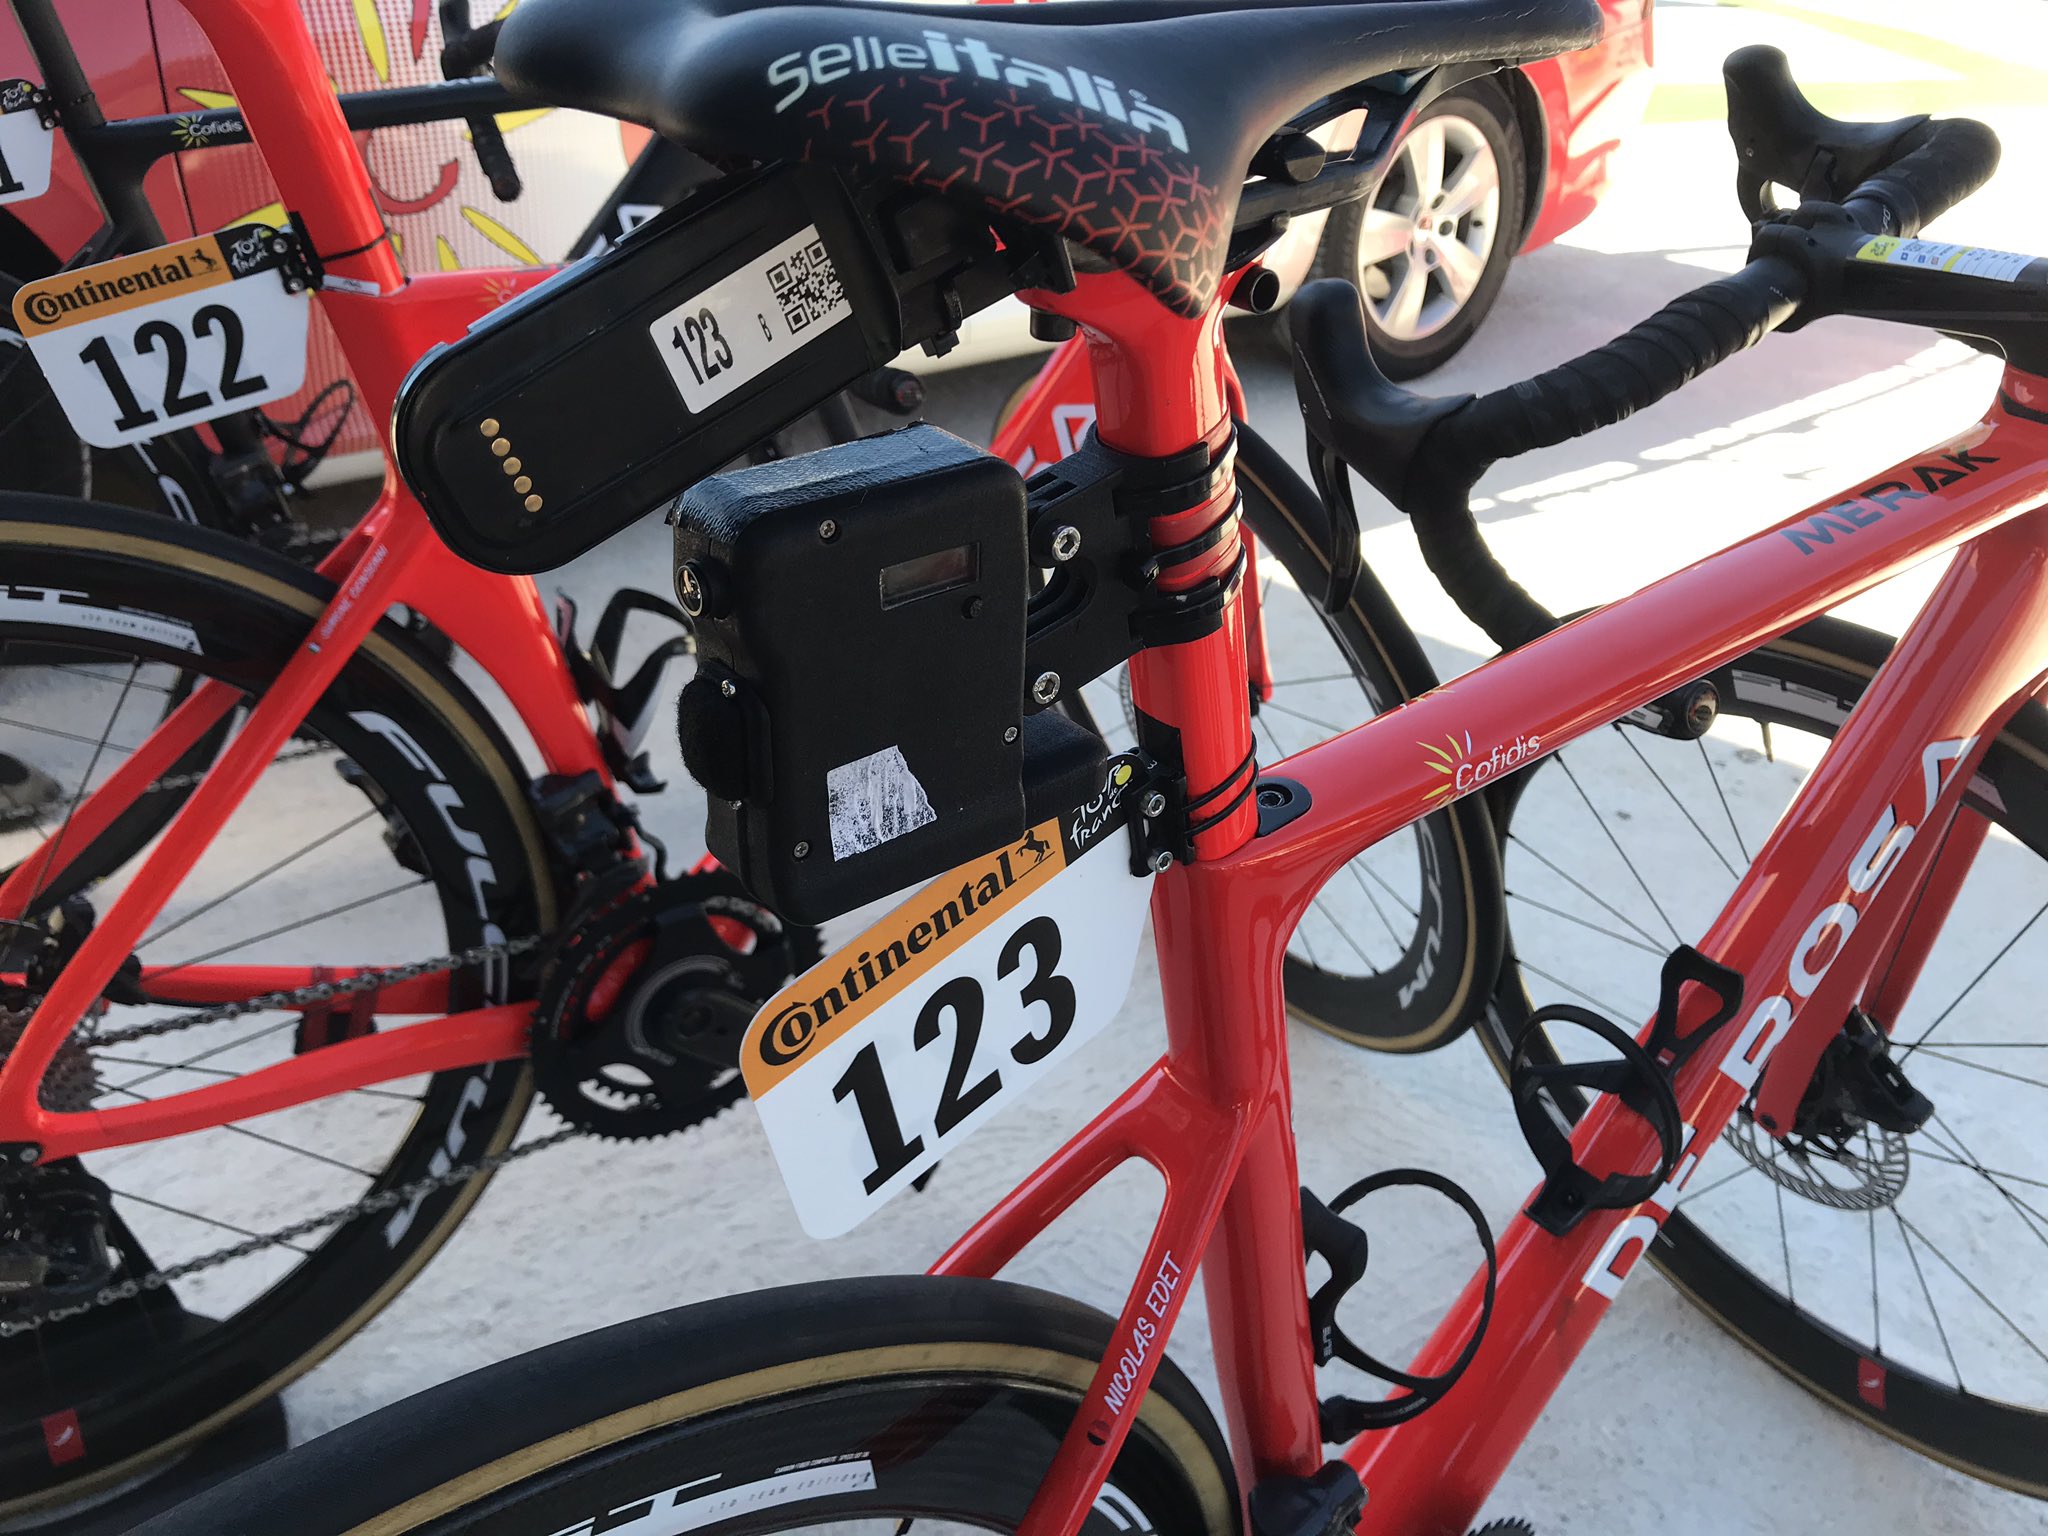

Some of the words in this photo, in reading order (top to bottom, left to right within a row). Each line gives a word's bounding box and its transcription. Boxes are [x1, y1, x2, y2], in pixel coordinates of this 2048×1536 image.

[189, 119, 243, 137] Cofidis
[23, 255, 193, 326] Continental
[78, 304, 269, 432] 122
[672, 307, 734, 386] 123
[757, 313, 773, 342] B
[1778, 445, 2001, 556] MERAK
[1455, 734, 1540, 791] Cofidis
[759, 850, 1018, 1067] Continental
[831, 915, 1077, 1197] 123
[1103, 1316, 1157, 1416] NICOLAS
[1144, 1250, 1182, 1319] EDET
